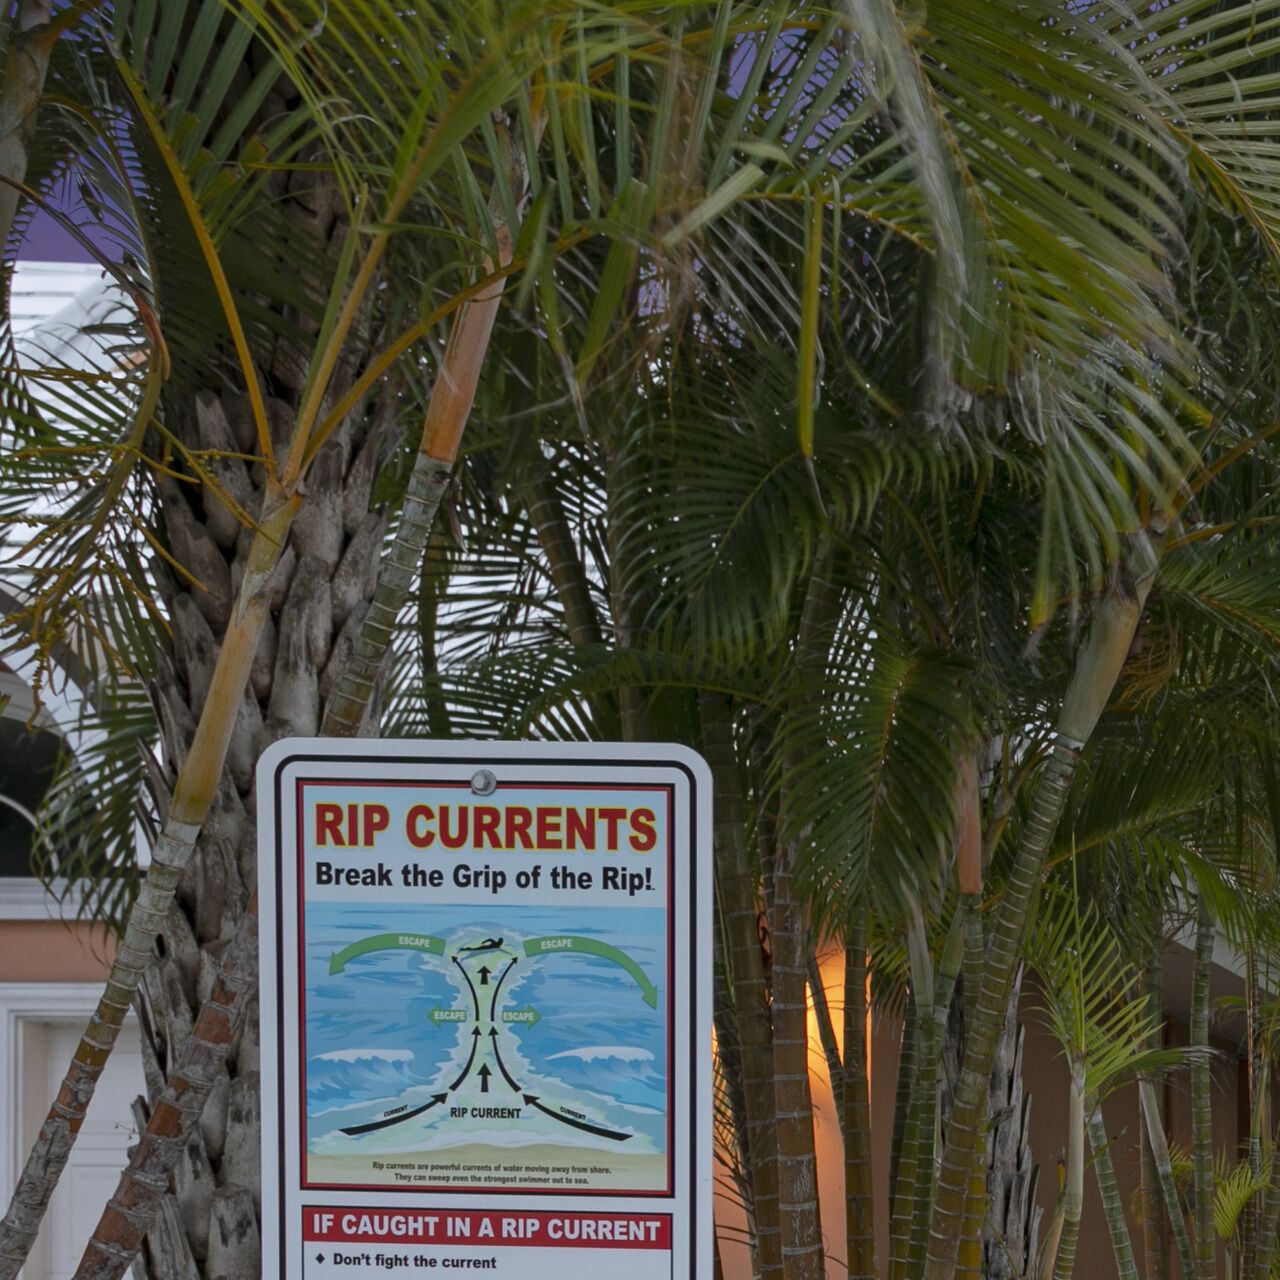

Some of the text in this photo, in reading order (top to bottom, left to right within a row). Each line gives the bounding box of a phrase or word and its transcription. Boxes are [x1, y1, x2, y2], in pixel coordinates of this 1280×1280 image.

[315, 803, 657, 852] RIP CURRENTS
[316, 862, 393, 886] Break
[402, 863, 443, 887] the
[453, 864, 506, 893] Grip
[516, 865, 541, 888] of
[550, 866, 592, 889] the
[399, 936, 430, 948] ESCAPE
[541, 938, 573, 950] ESCAPE
[434, 1011, 465, 1020] ESCAPE
[503, 1012, 534, 1021] ESCAPE
[383, 1105, 408, 1117] CURRENT
[450, 1107, 521, 1119] RIP CURRENT
[560, 1107, 586, 1120] CURRENT
[373, 1162, 384, 1170] Rip
[386, 1162, 415, 1170] currents
[431, 1163, 460, 1172] powerful
[462, 1164, 492, 1172] currents
[494, 1164, 501, 1172] of
[525, 1165, 550, 1174] moving
[552, 1166, 569, 1175] away
[590, 1166, 611, 1174] shore.
[395, 1173, 411, 1182] They
[428, 1175, 450, 1183] sweep
[484, 1175, 517, 1184] strongest
[313, 1214, 661, 1241] IF CAUGHT IN A RIP CURRENT
[333, 1254, 497, 1269] Don't fight the current
